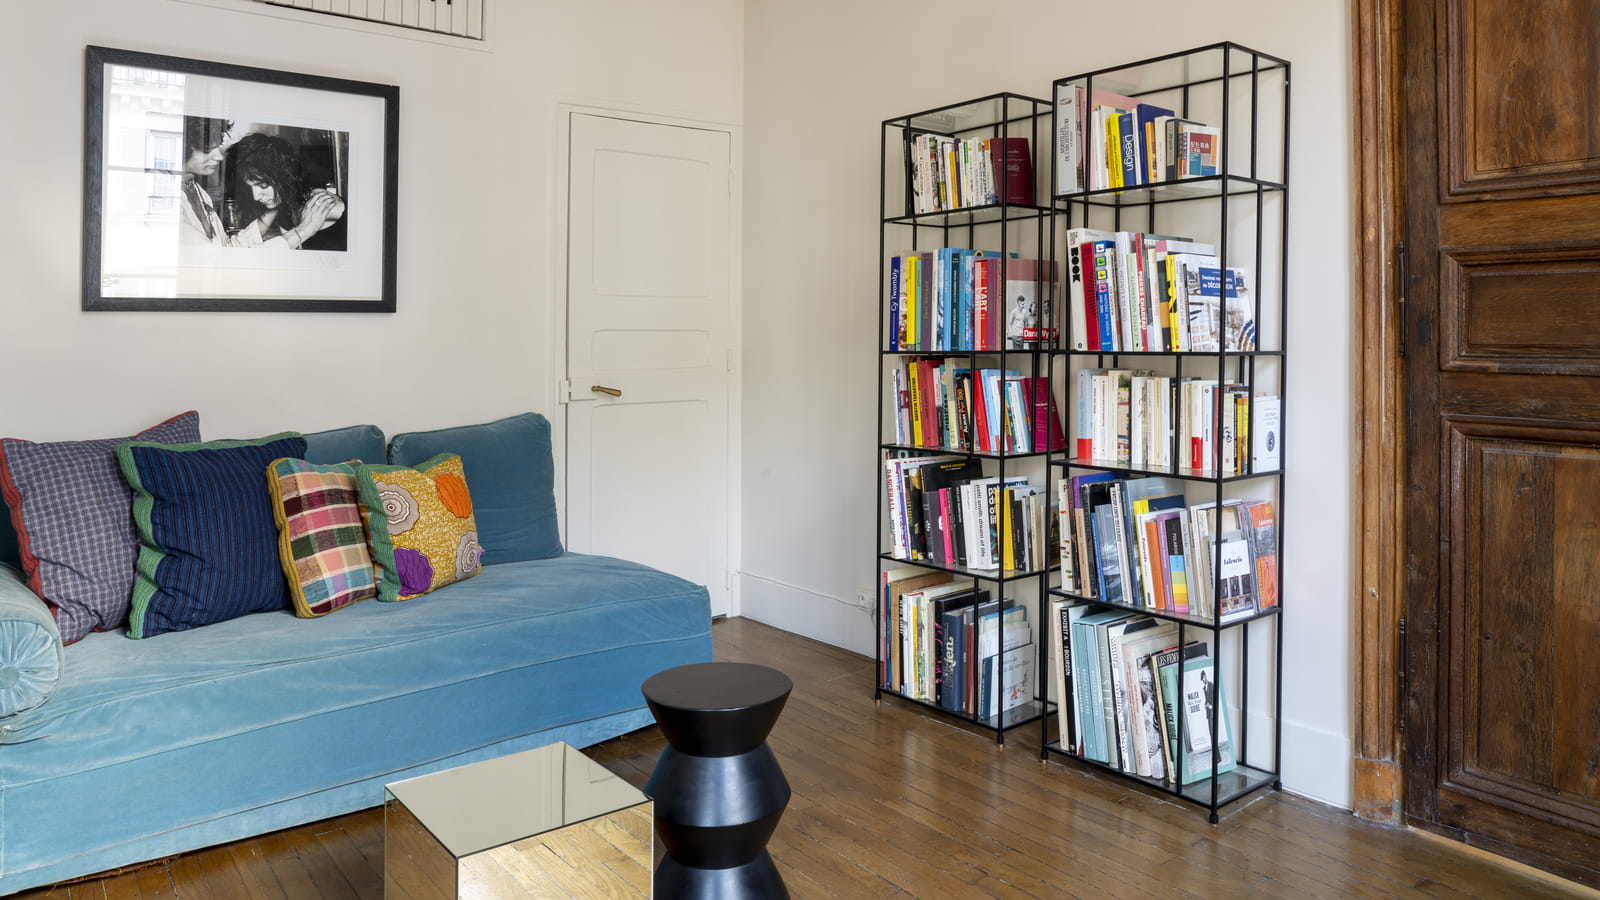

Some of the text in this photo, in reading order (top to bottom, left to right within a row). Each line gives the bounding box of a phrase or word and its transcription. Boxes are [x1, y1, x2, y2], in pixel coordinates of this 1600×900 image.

[1123, 134, 1136, 172] Design
[1070, 246, 1081, 283] BOOK
[891, 268, 899, 299] Twombly
[980, 286, 988, 311] L'ART
[891, 301, 897, 312] Cy
[887, 469, 895, 511] DANCEHALL
